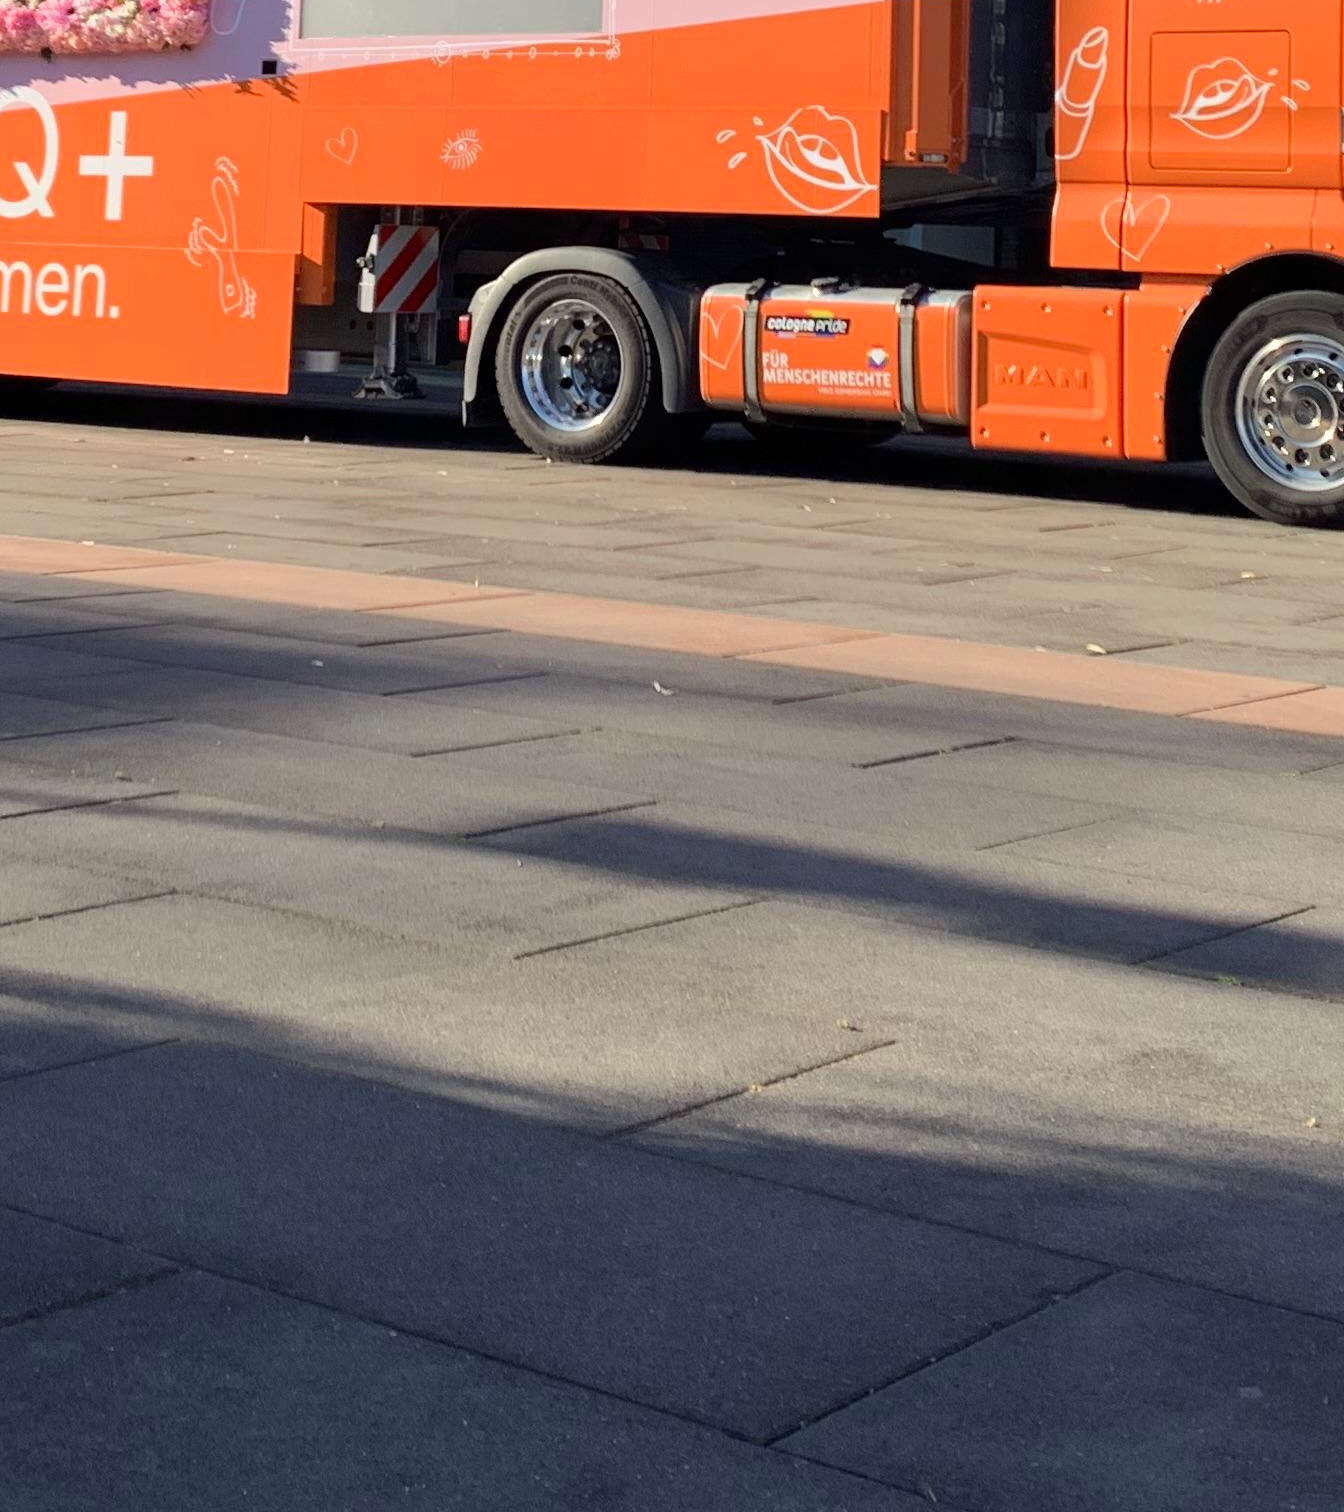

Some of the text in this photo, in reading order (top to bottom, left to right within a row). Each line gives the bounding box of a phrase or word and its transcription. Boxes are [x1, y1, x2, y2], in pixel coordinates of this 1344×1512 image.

[767, 316, 848, 334] cologne pride
[761, 349, 789, 369] FÜR
[763, 368, 892, 388] MENSCHENRECHTE
[995, 363, 1088, 391] MAN
